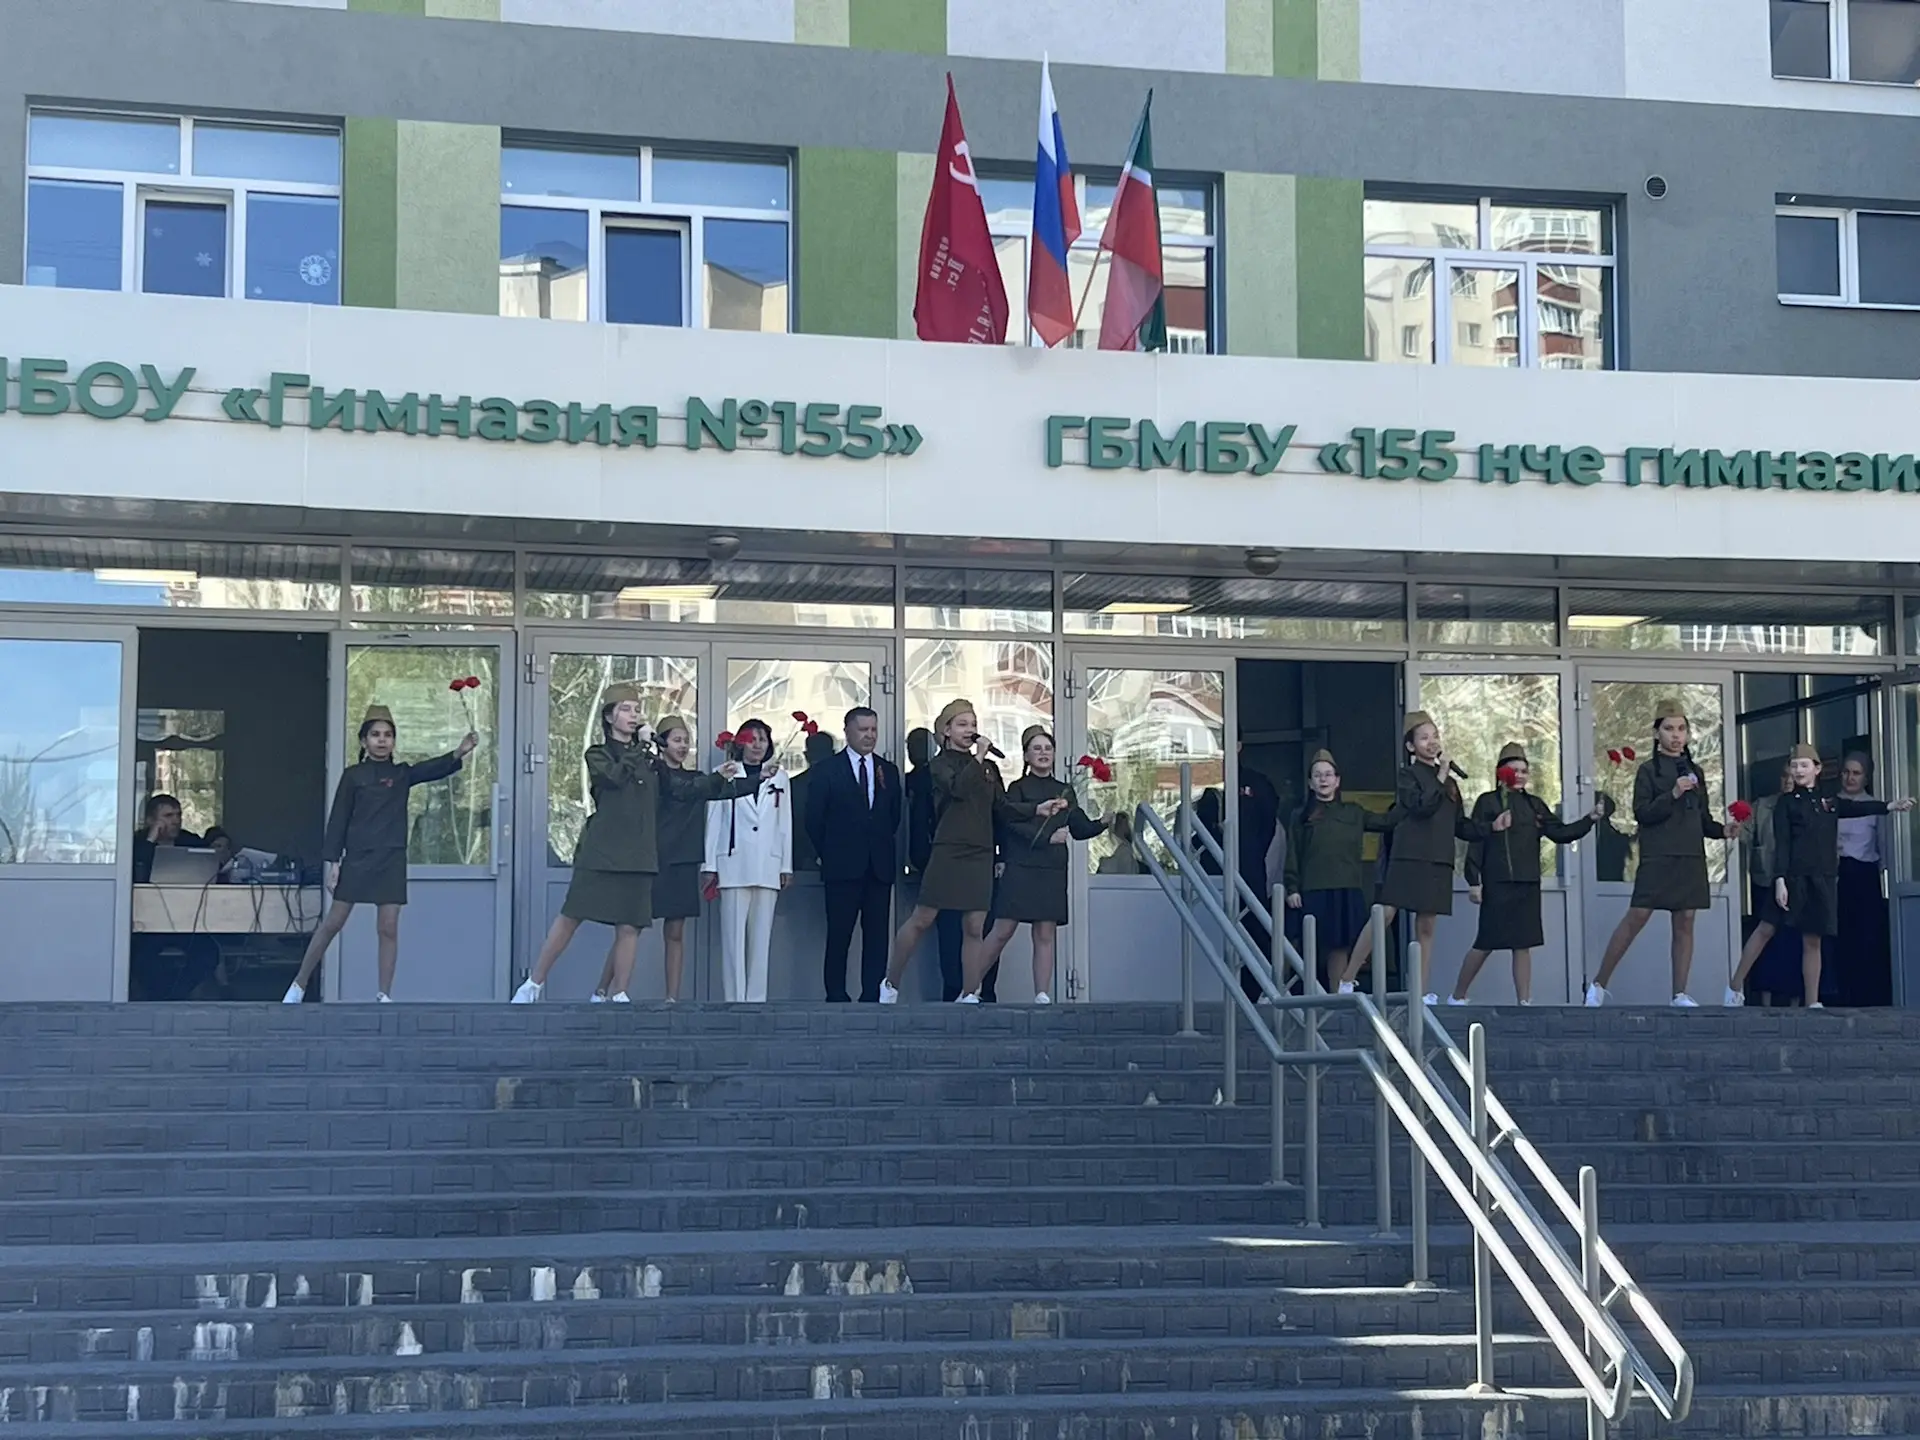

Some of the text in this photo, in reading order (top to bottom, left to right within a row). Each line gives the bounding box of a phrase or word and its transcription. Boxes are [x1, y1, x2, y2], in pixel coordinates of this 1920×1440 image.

[0, 357, 923, 459] БОУ «Гимназия №155»
[1047, 415, 1920, 492] ГБМБУ «155 нче гимнази
